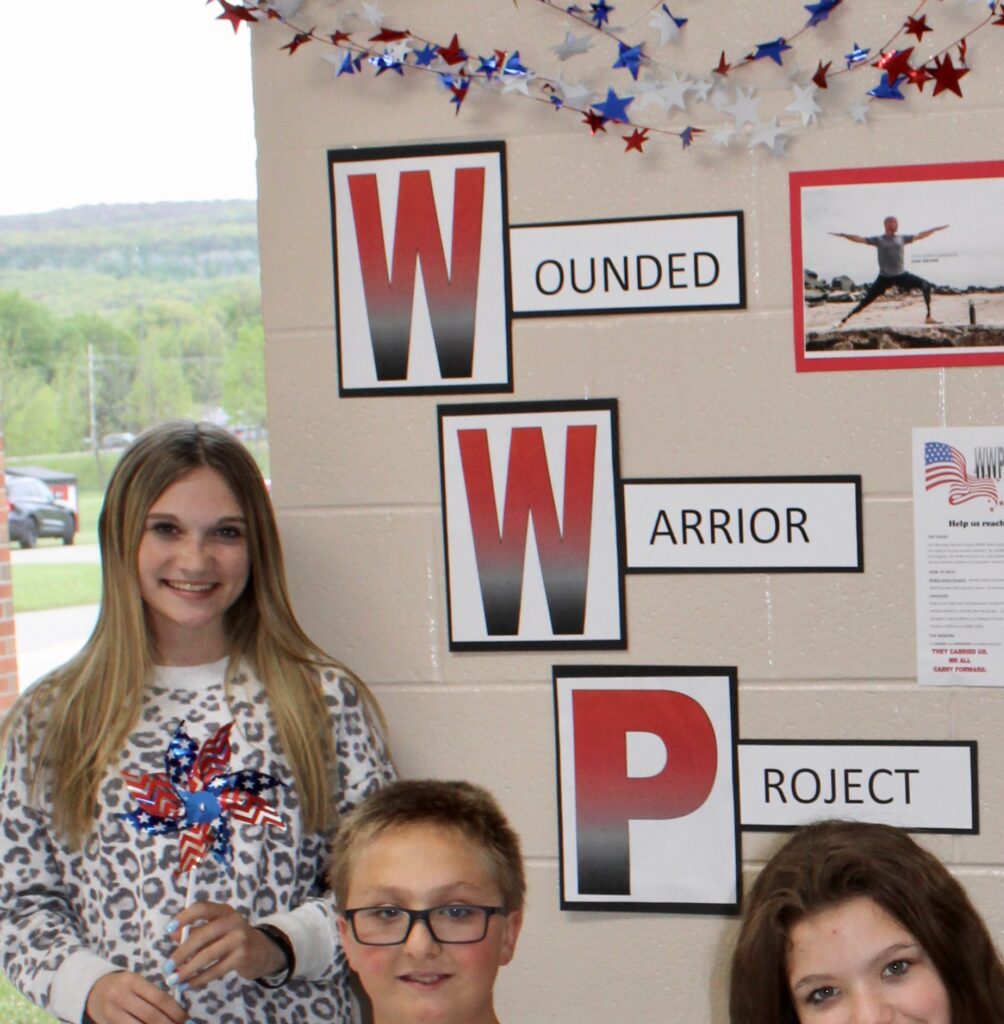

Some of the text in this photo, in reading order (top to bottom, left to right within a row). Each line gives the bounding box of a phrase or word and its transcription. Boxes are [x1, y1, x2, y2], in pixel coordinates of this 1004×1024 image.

[347, 167, 721, 382] W OUNDED
[457, 425, 811, 636] W ARRIOR
[949, 520, 968, 528] Help
[974, 446, 1004, 479] WWP
[571, 689, 920, 896] P ROJECT
